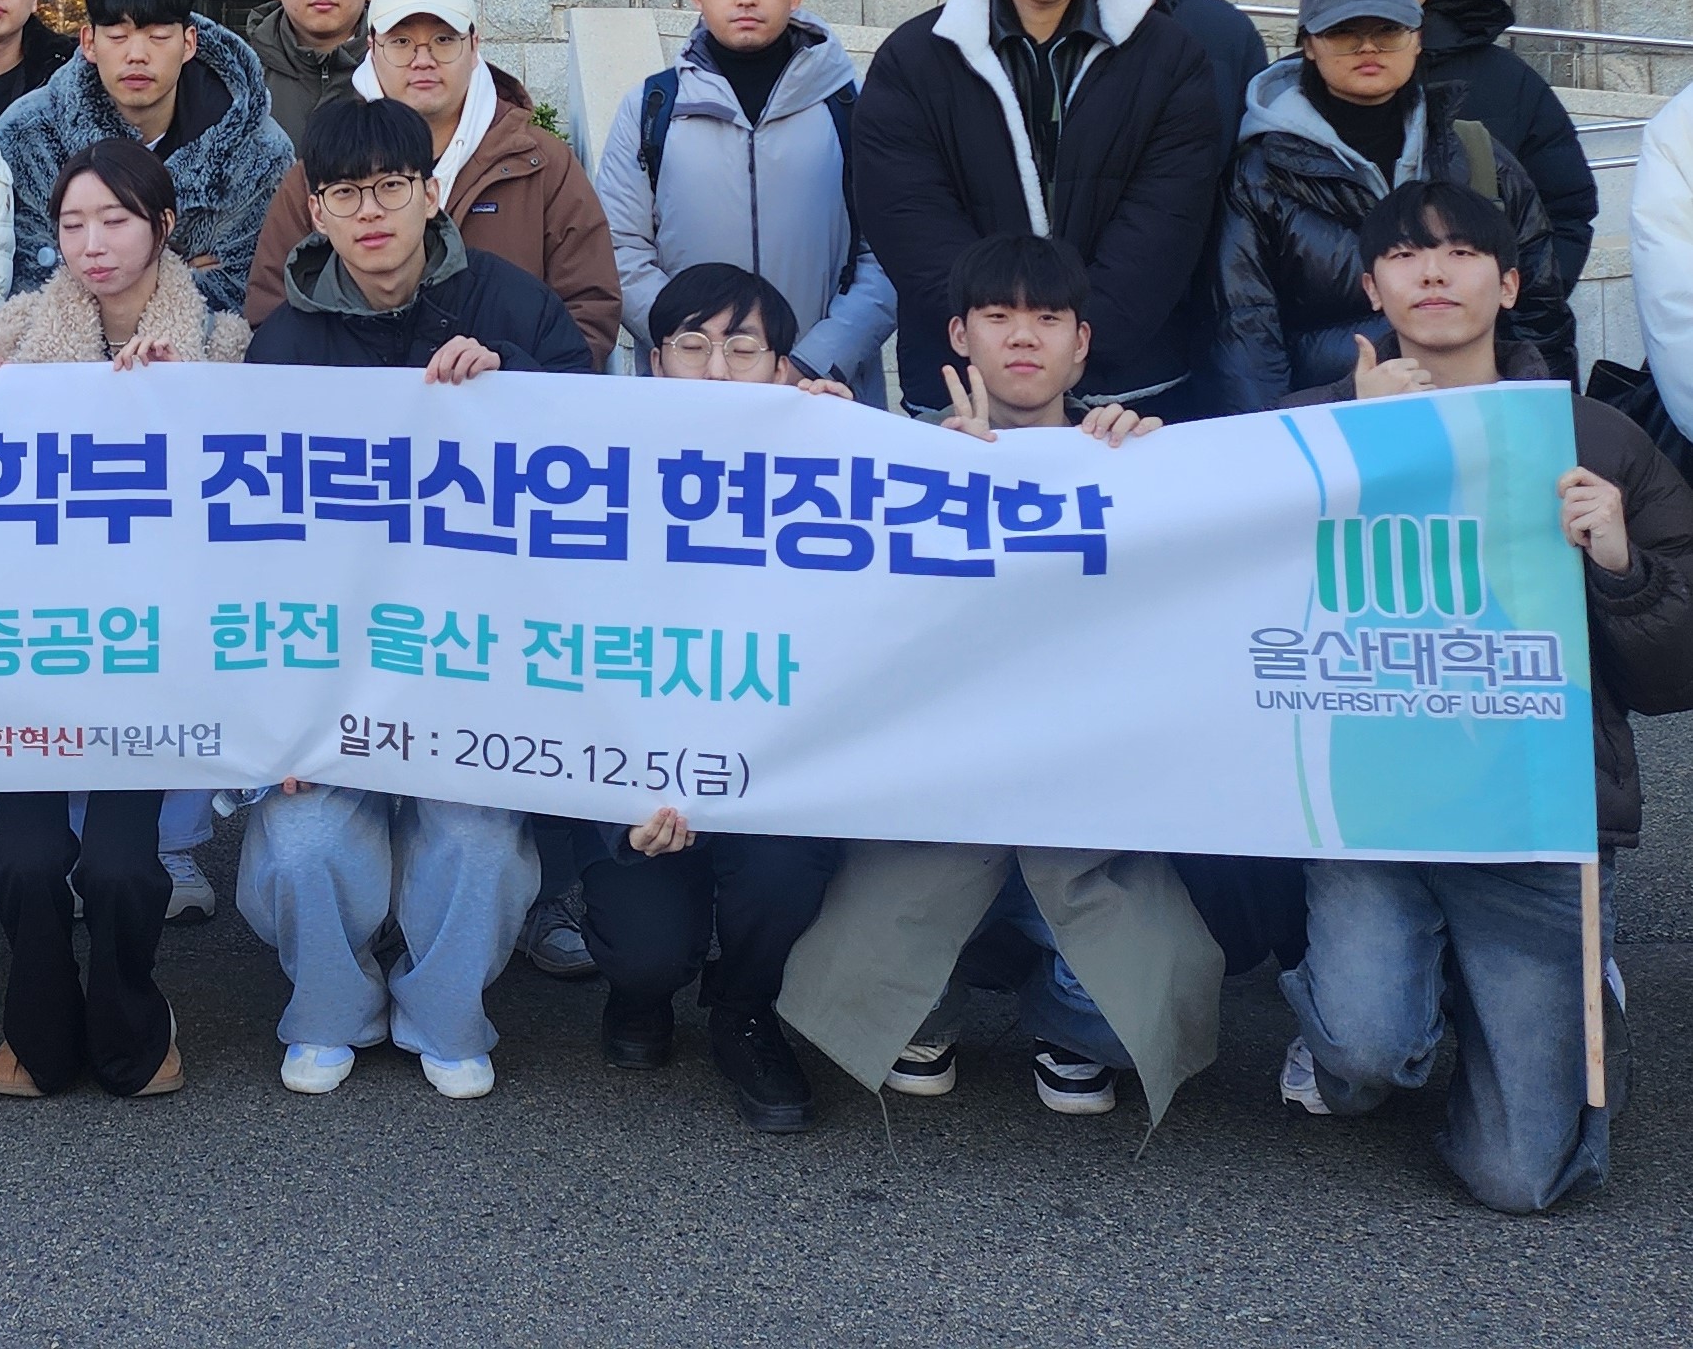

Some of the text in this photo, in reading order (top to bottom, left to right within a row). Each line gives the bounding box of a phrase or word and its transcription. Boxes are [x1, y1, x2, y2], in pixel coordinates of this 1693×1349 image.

[201, 432, 631, 561] 전력산업
[657, 448, 1113, 578] 현장견학
[209, 599, 341, 673] 한전
[365, 601, 500, 683] 울산
[521, 618, 801, 708] 전력지사
[1248, 626, 1563, 688] 울산대학교
[1255, 689, 1562, 716] UNIVERSITY OF ULSAN
[338, 713, 415, 762] 일자
[454, 728, 751, 799] 2025.12.5(금)
